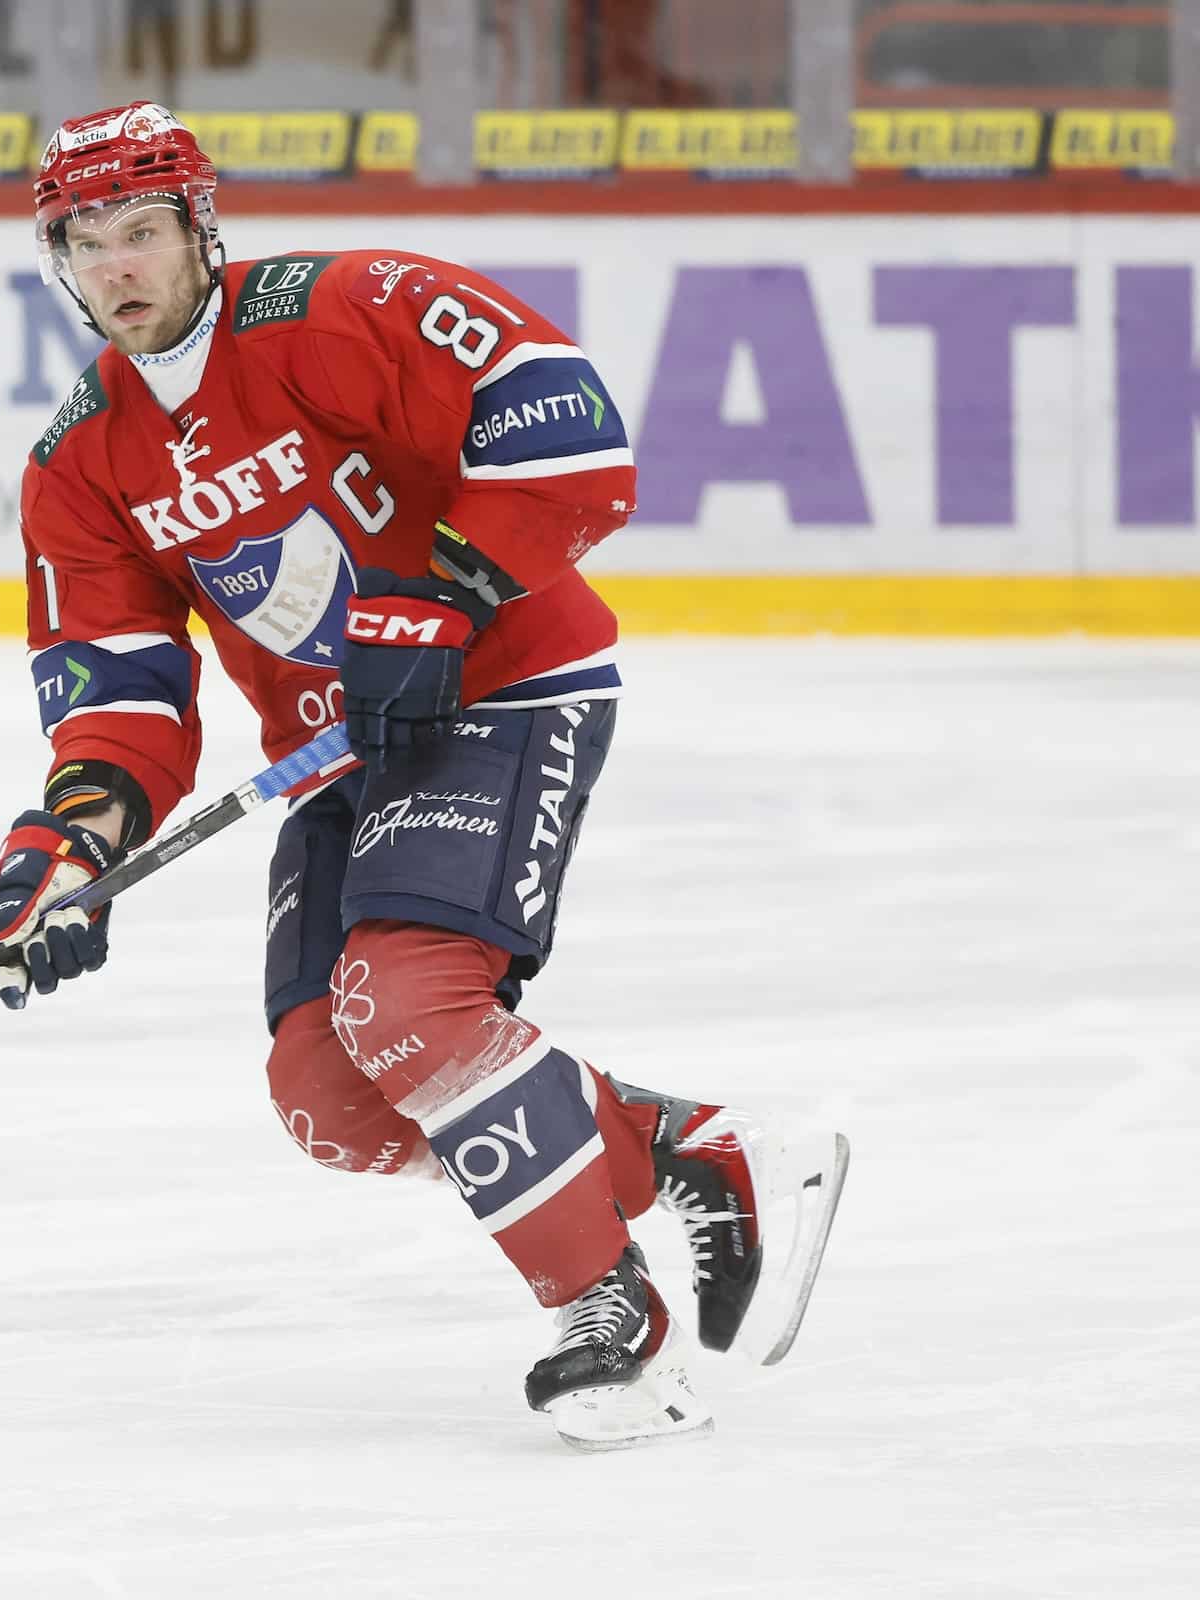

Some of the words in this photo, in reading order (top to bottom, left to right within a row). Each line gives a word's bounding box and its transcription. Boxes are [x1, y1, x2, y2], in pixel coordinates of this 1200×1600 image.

[73, 131, 107, 145] Aktia
[66, 159, 121, 183] CCM
[256, 262, 314, 294] UB
[240, 304, 300, 327] BANKERS
[247, 295, 296, 314] UNITED
[418, 284, 527, 370] 81
[472, 393, 588, 449] GIGANTTI
[130, 429, 308, 551] KOFF
[329, 450, 396, 537] C
[212, 565, 269, 597] 1897
[346, 608, 444, 643] CM
[82, 831, 109, 869] CCM
